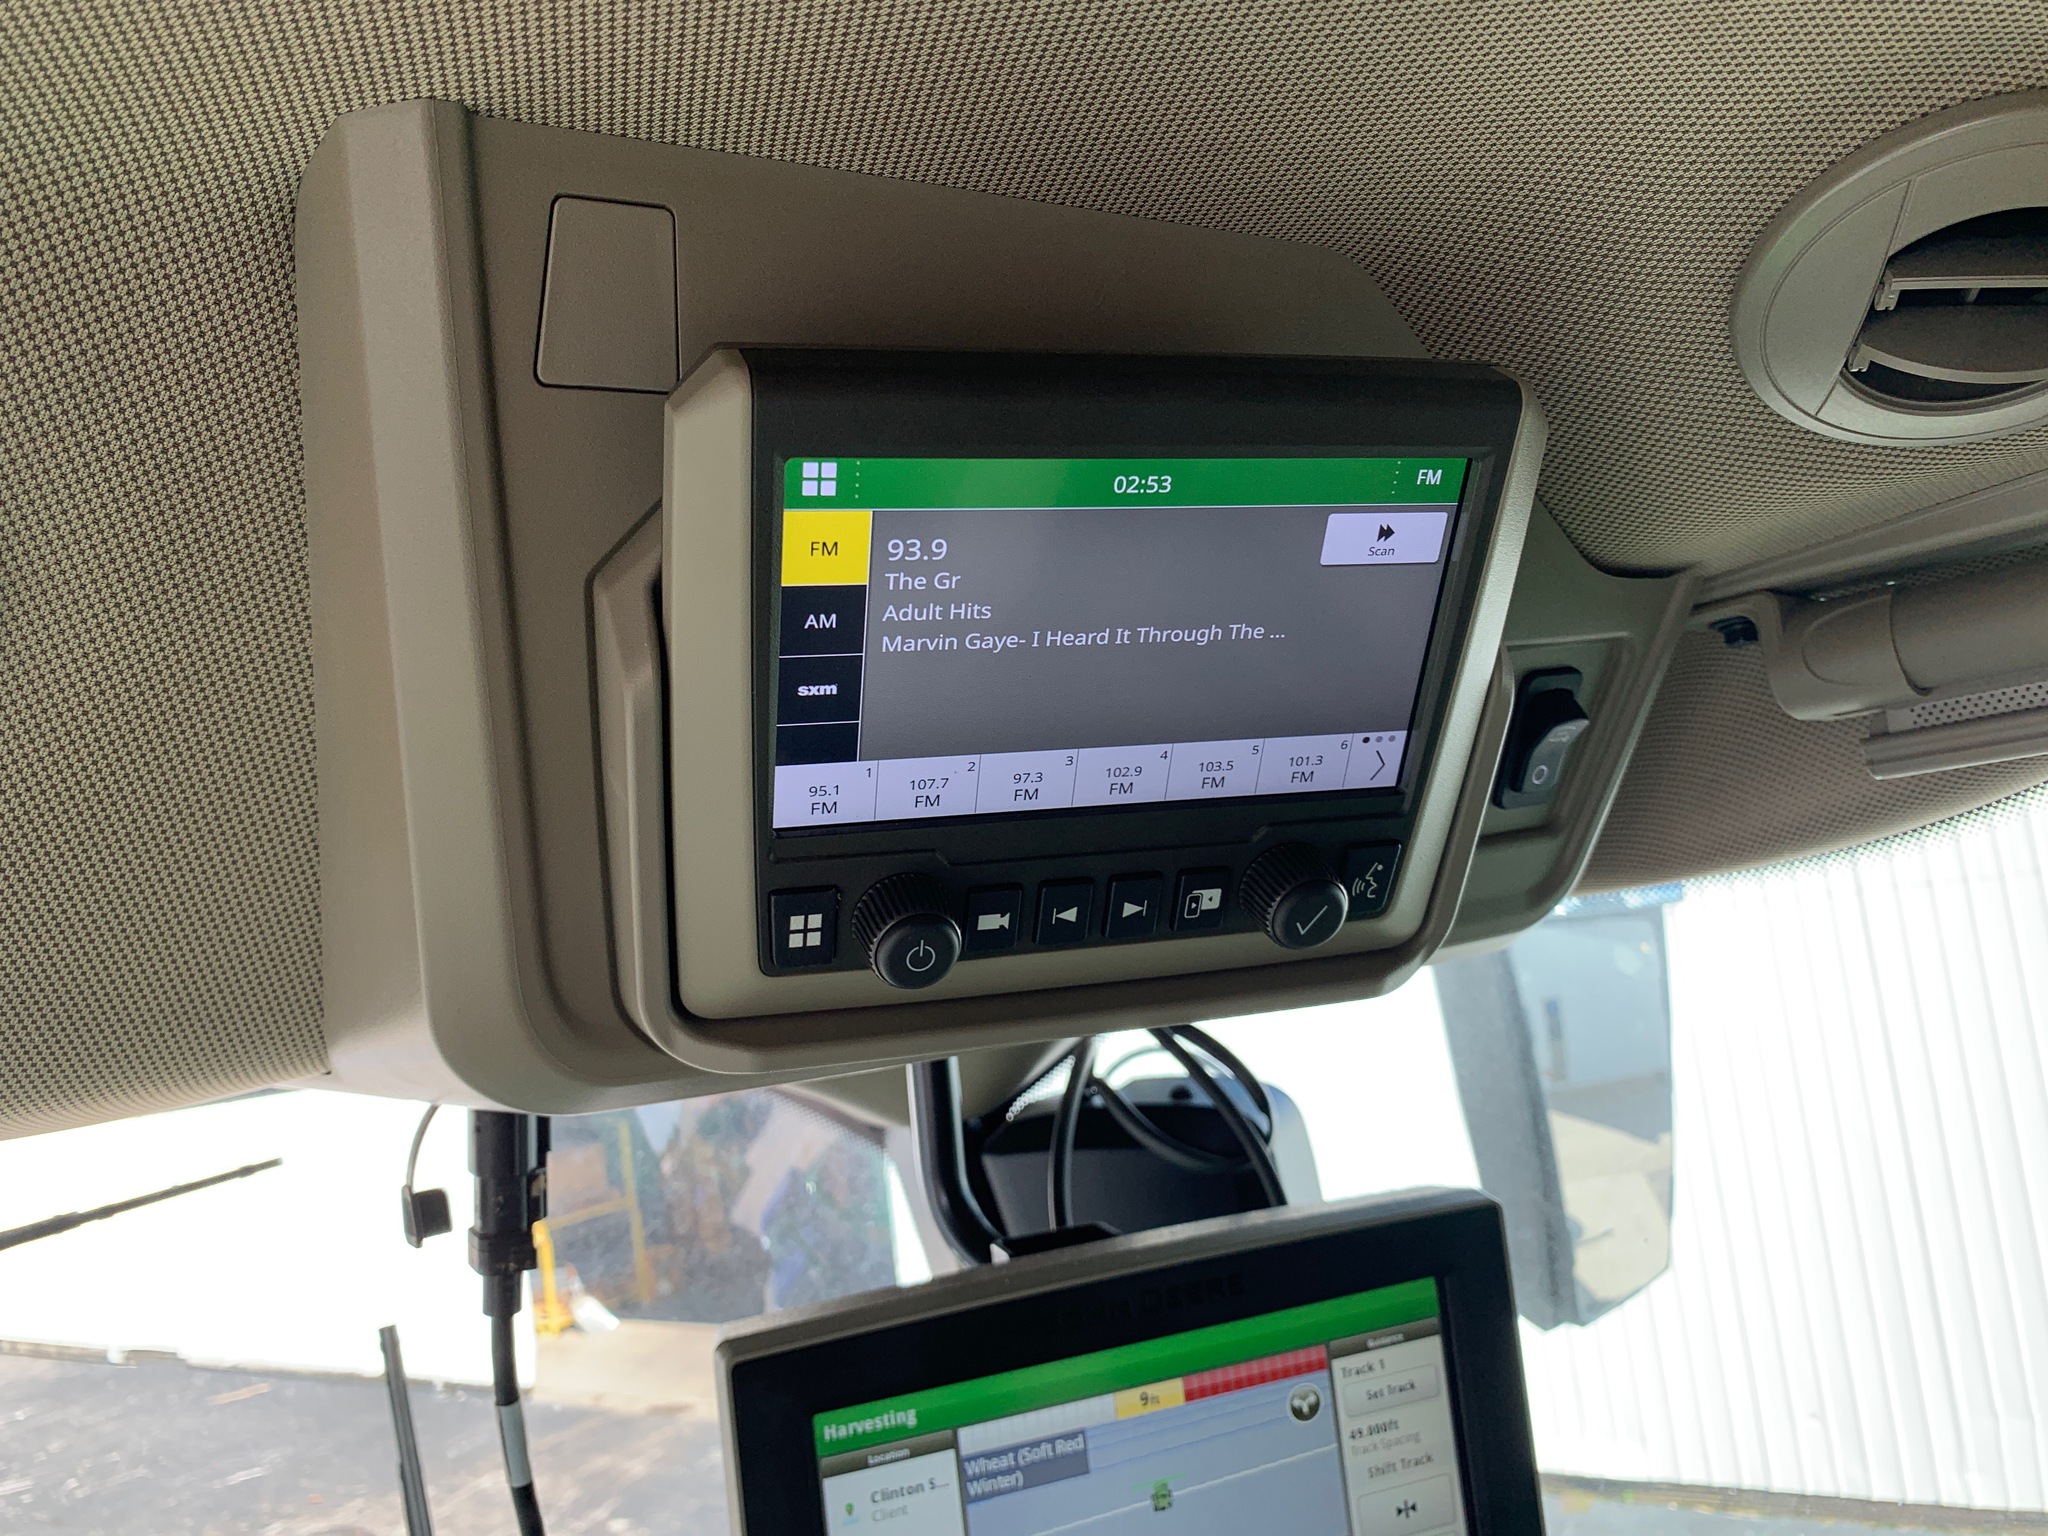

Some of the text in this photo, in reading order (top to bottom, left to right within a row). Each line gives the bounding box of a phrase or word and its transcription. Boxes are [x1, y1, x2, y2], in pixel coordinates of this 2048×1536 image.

[1113, 475, 1172, 494] 02:53
[1416, 469, 1443, 486] FM
[810, 541, 839, 557] FM
[886, 538, 948, 561] 93.9
[1367, 546, 1395, 557] Scan
[884, 572, 961, 591] The Gr
[882, 603, 992, 622] Adult Hits
[804, 613, 837, 629] AM
[881, 634, 958, 653] Marvin
[965, 632, 1026, 654] Gaye-
[1031, 631, 1039, 647] I
[1046, 628, 1109, 646] Heard
[1115, 628, 1132, 645] It
[1137, 624, 1223, 646] Through
[1228, 623, 1265, 640] The
[797, 683, 838, 697] sxm
[1251, 745, 1260, 755] 5
[1340, 739, 1349, 750] 6
[1065, 755, 1074, 767] 3
[1159, 750, 1168, 761] 4
[1288, 755, 1323, 768] 101.3
[865, 767, 872, 778] 1
[967, 761, 976, 773] 2
[1105, 765, 1143, 779] 102.9
[1198, 760, 1234, 773] 103.5
[909, 778, 949, 791] 107.7
[1013, 771, 1043, 785] 97.3
[1201, 776, 1225, 790] FM
[1290, 771, 1314, 784] FM
[808, 784, 840, 798] 95.1
[1013, 788, 1039, 802] FM
[1109, 782, 1134, 795] FM
[810, 801, 838, 815] FM
[914, 794, 940, 808] FM
[823, 1408, 918, 1443] Harvesting
[866, 1448, 911, 1467] Location
[964, 1434, 1085, 1478] Wheat (Soft Red
[966, 1470, 1024, 1498] Winter)
[870, 1479, 926, 1504] Clinton
[871, 1504, 909, 1524] Client
